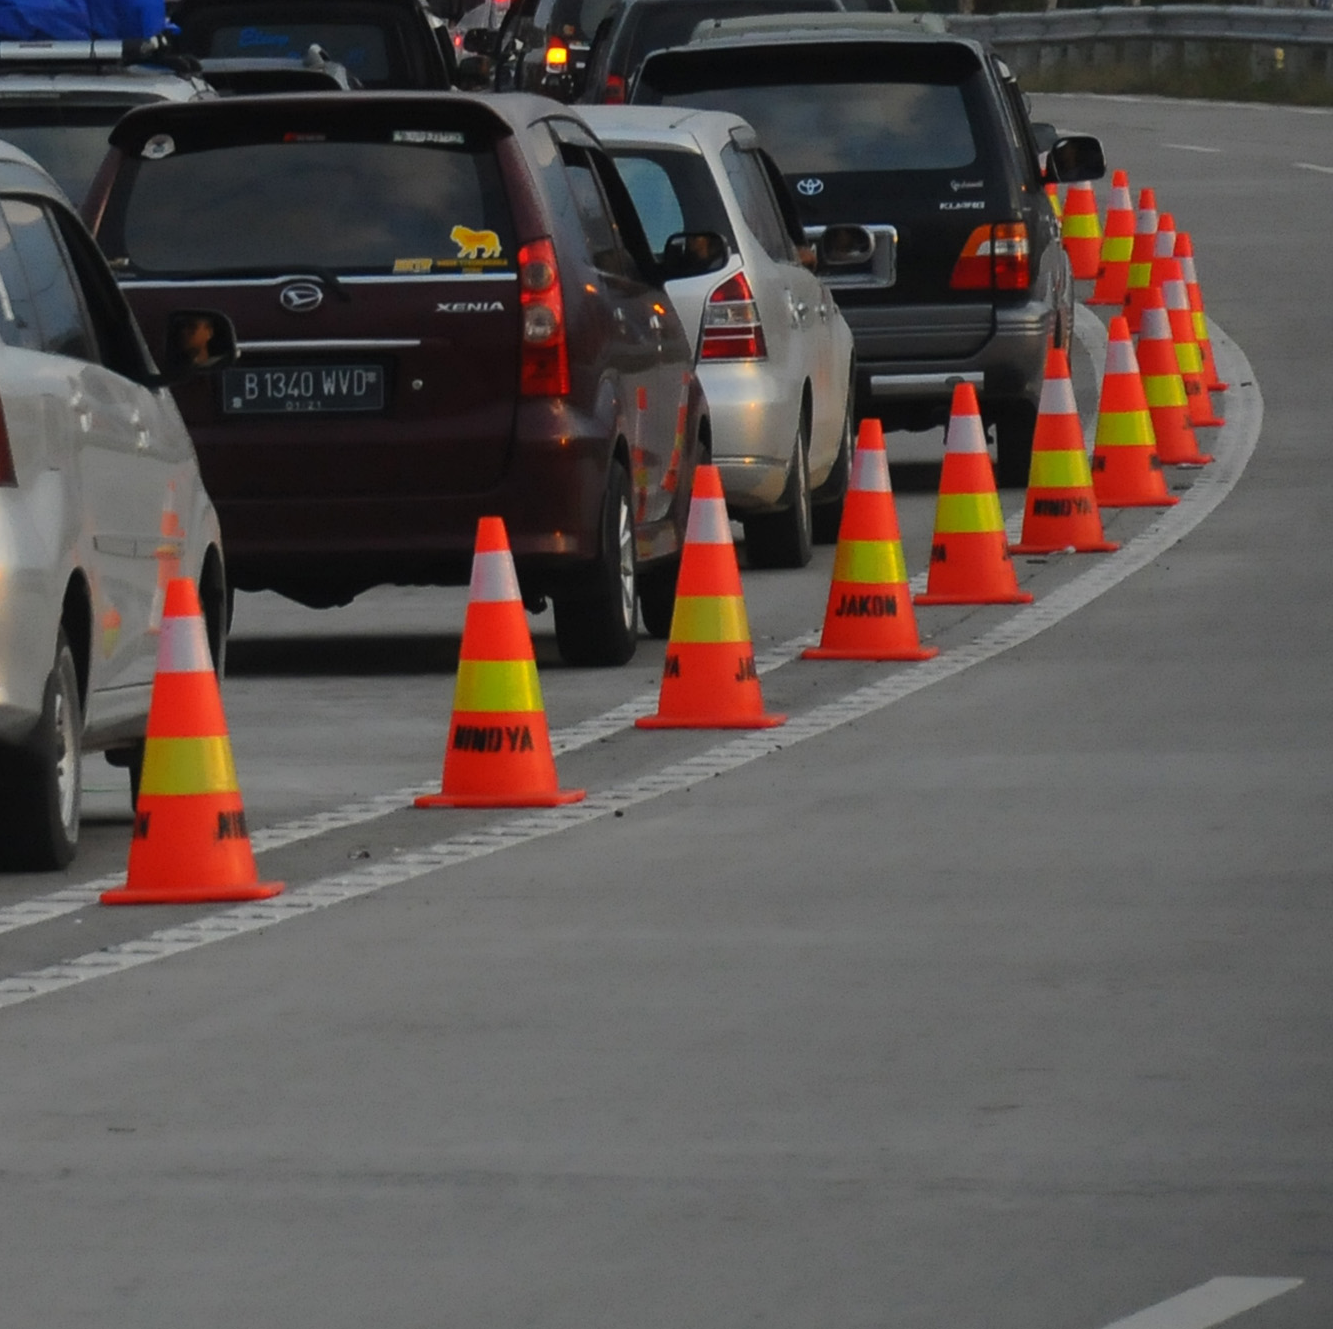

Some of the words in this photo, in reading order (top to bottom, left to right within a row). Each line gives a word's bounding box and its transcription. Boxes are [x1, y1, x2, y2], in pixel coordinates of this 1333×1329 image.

[435, 301, 506, 313] XENIA
[244, 373, 259, 401] B
[263, 371, 315, 399] 1340
[321, 369, 367, 397] WVD
[835, 593, 897, 618] JAKON
